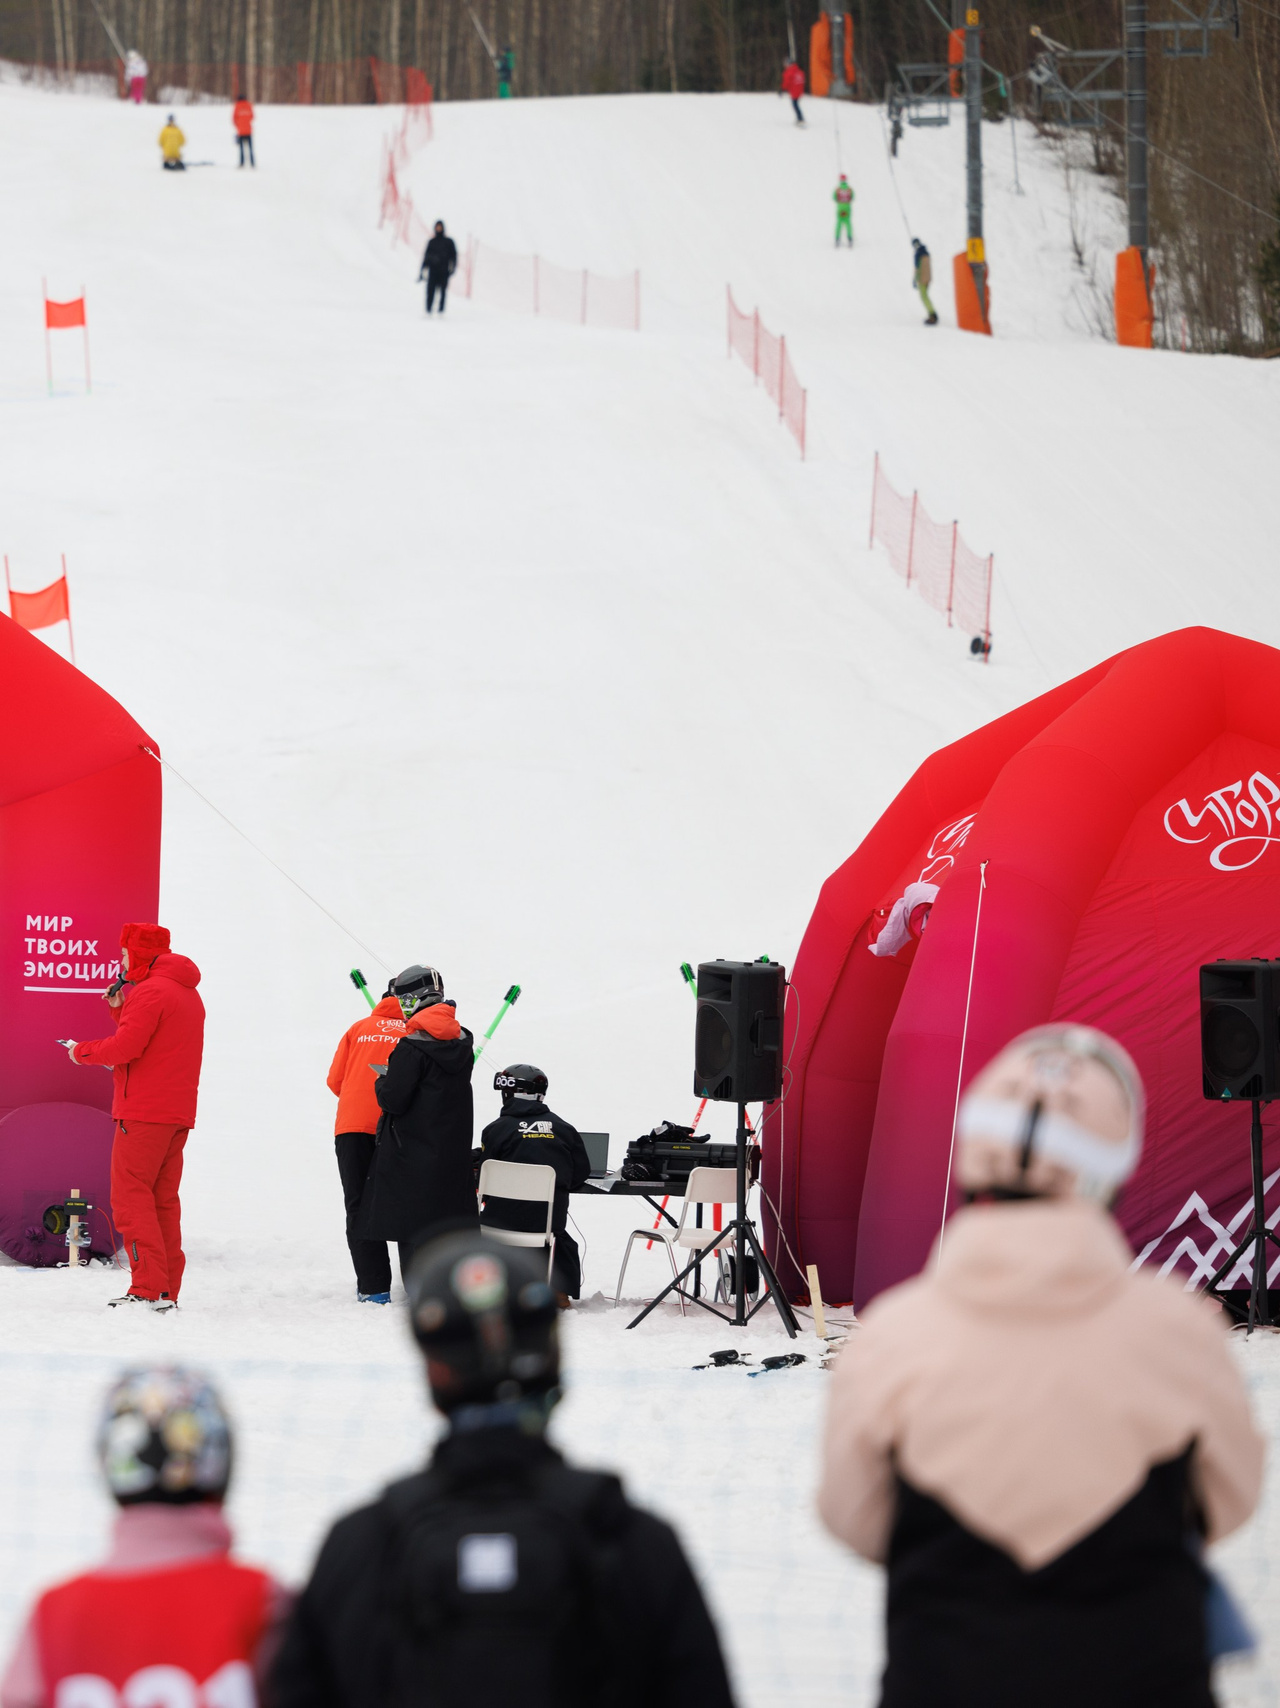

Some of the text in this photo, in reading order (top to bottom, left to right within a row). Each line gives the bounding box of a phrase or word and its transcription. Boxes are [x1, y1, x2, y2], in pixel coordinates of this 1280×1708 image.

[1163, 770, 1280, 871] ИГОР
[26, 914, 74, 932] МИР
[24, 937, 99, 956] ТВОИХ
[23, 959, 120, 981] ЭМОЦИЙ
